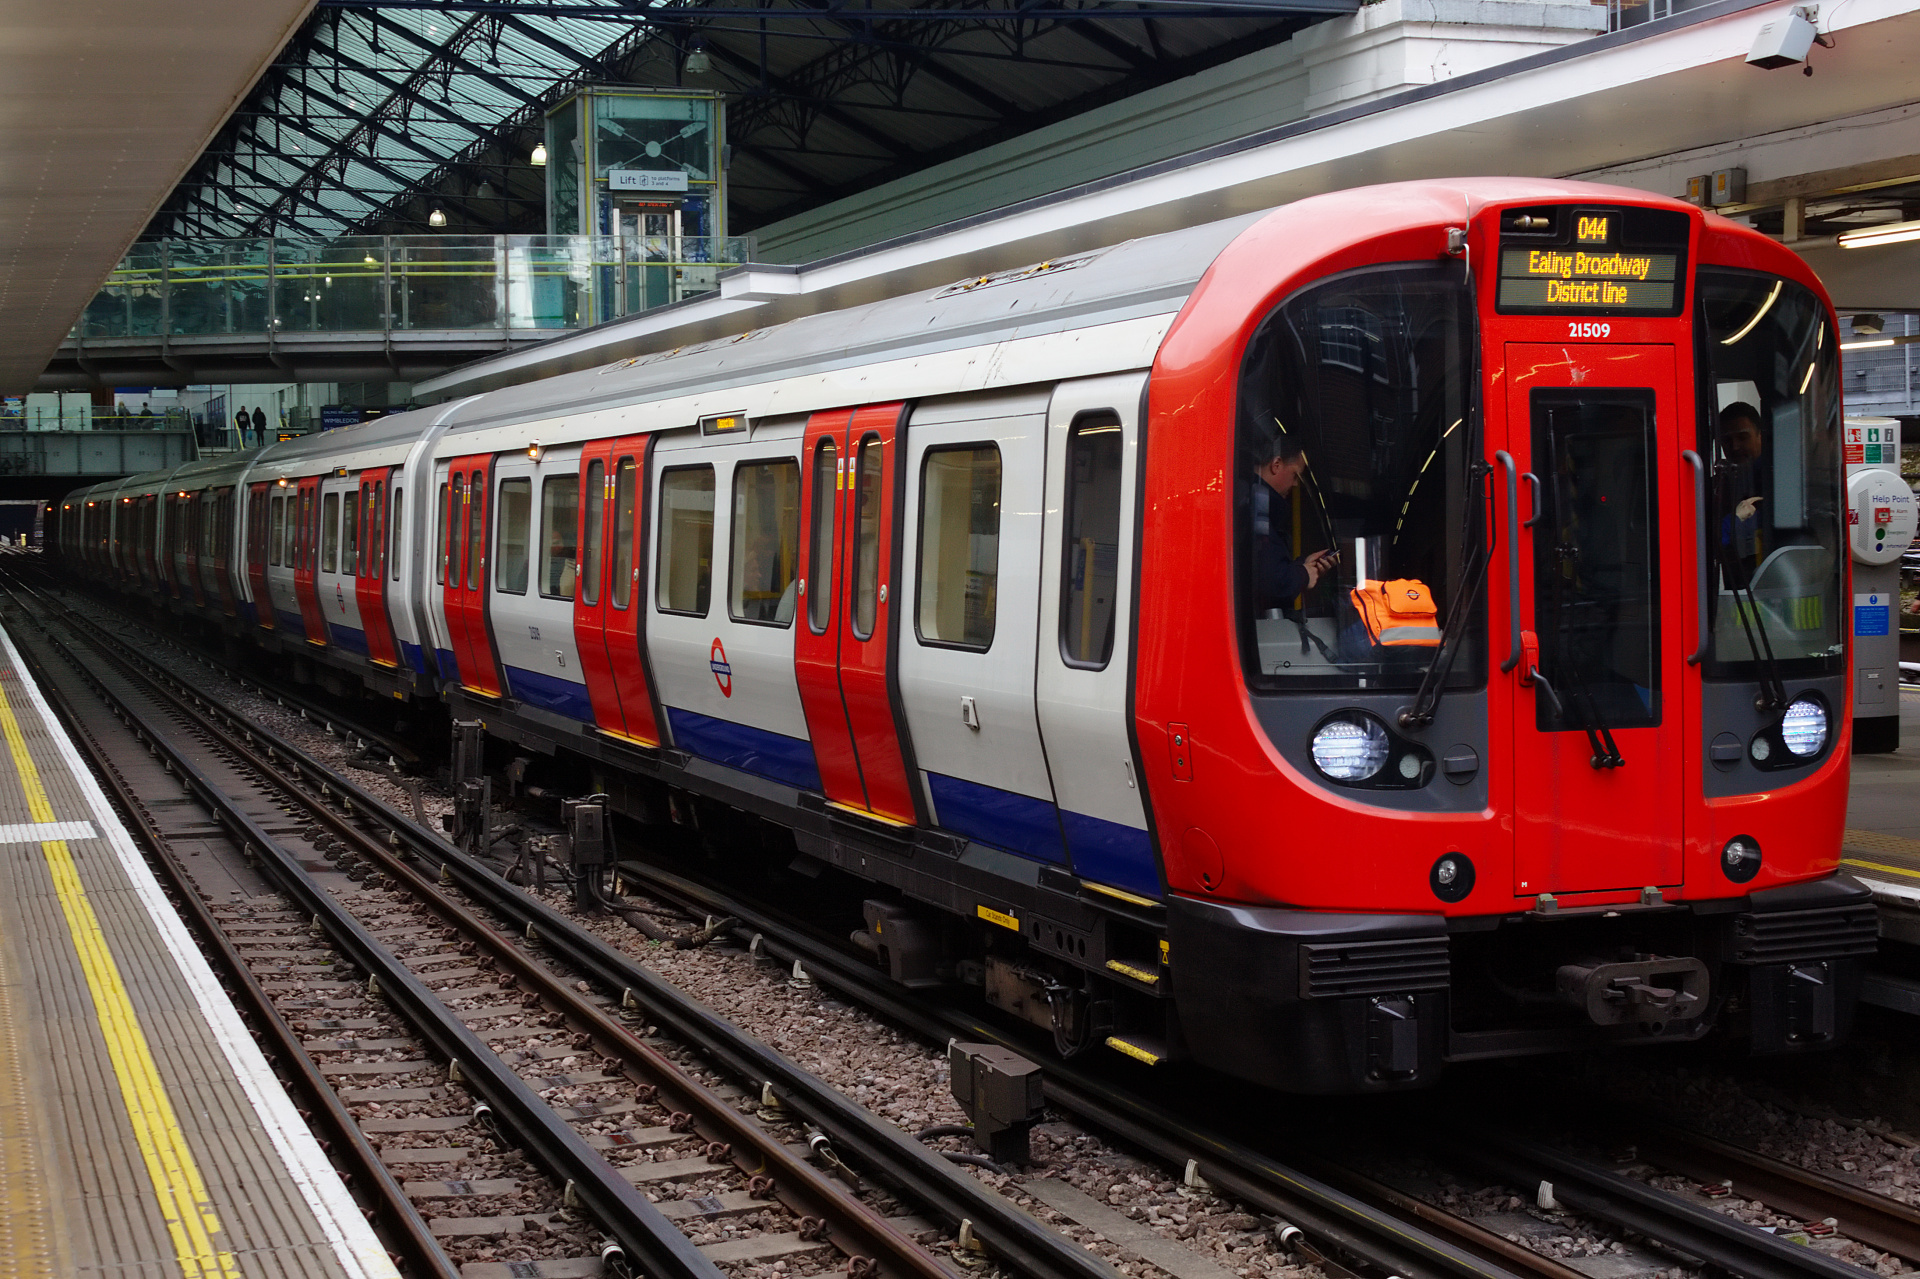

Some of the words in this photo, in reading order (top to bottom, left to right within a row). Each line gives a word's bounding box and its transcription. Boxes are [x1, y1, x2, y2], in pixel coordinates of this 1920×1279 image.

[620, 176, 637, 185] Lift
[1578, 217, 1607, 240] 044
[1528, 251, 1572, 279] Ealing
[1575, 252, 1651, 281] Broadway
[1547, 280, 1599, 303] District
[1602, 281, 1628, 304] line
[1568, 323, 1611, 338] 21509
[1872, 495, 1890, 504] Help
[1892, 495, 1910, 504] Point
